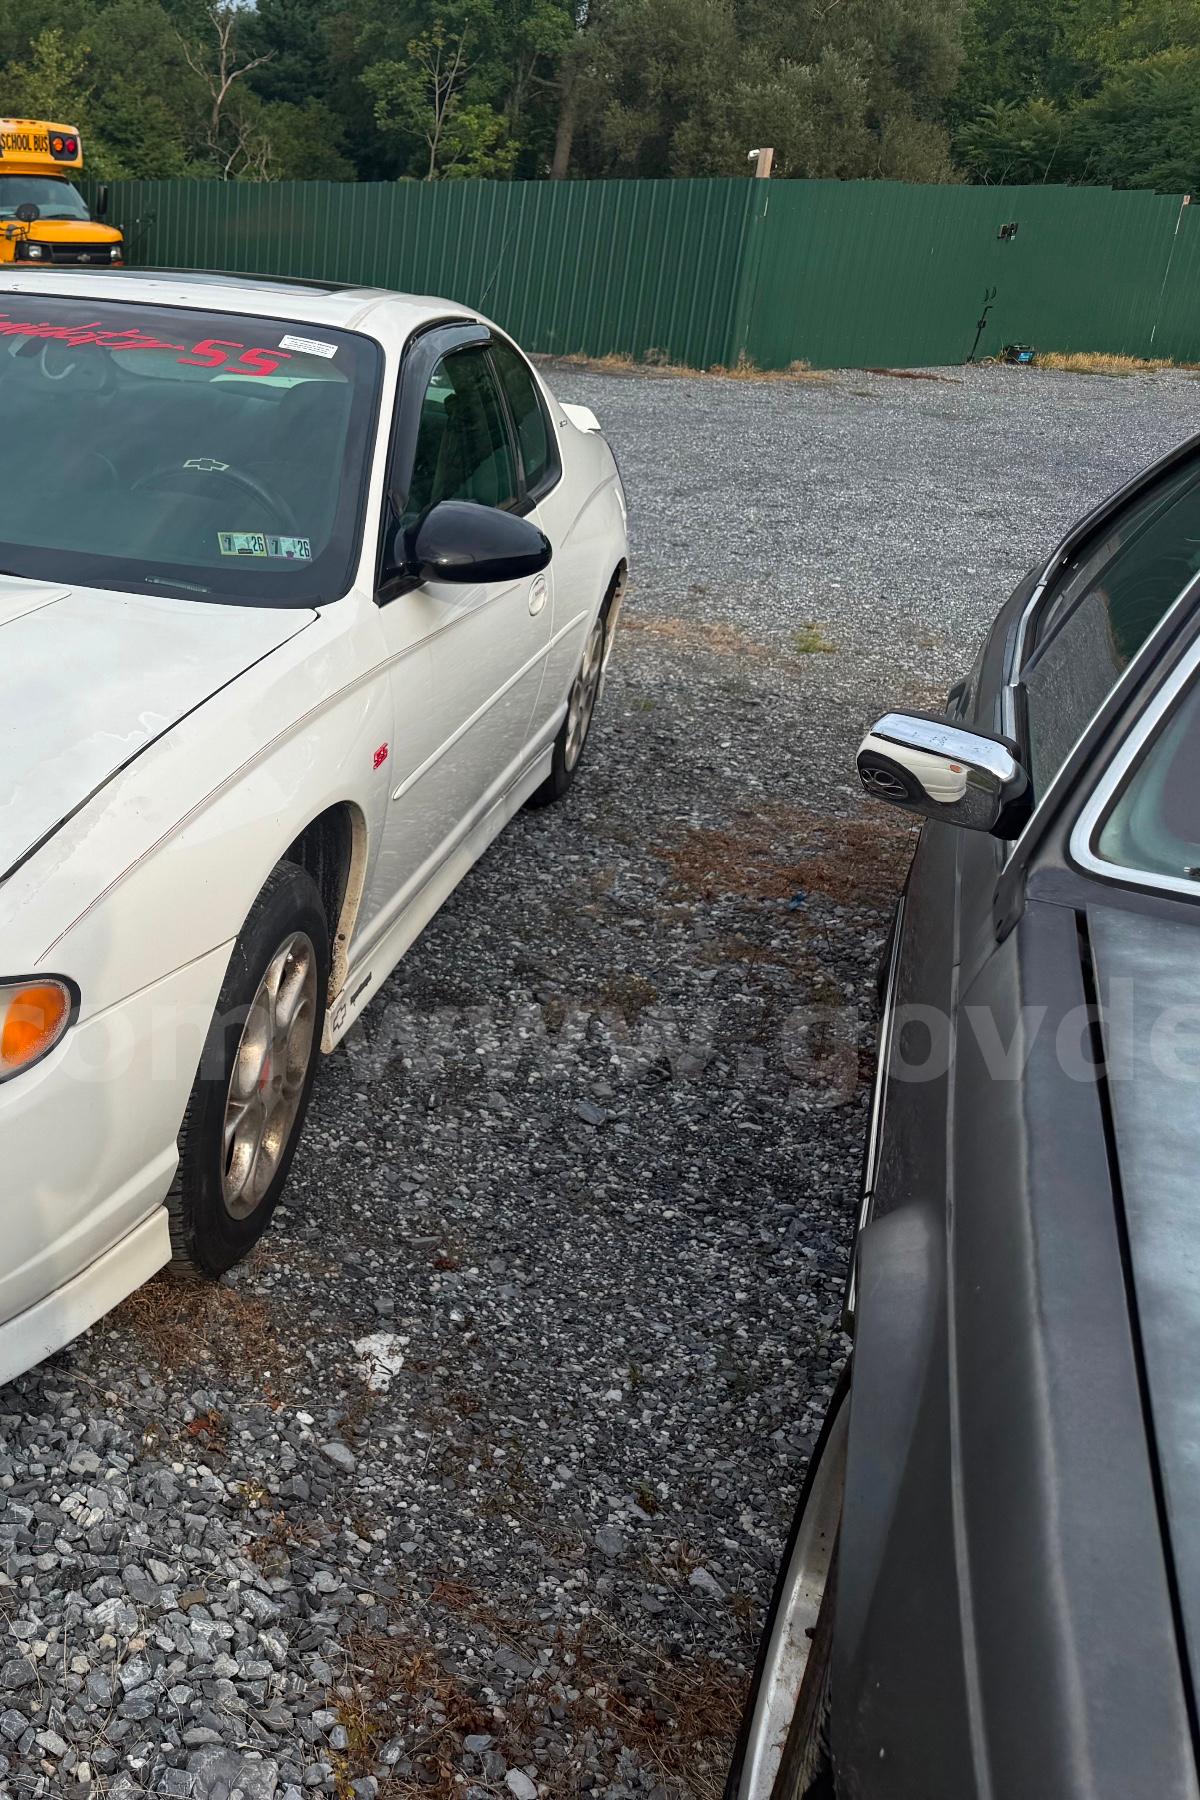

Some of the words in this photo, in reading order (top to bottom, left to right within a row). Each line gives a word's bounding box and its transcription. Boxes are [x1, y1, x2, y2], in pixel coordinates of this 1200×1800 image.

[1, 133, 31, 151] SCHOOL
[34, 135, 48, 152] BUS
[176, 339, 292, 376] SS
[251, 535, 264, 552] 26
[297, 540, 310, 558] 26
